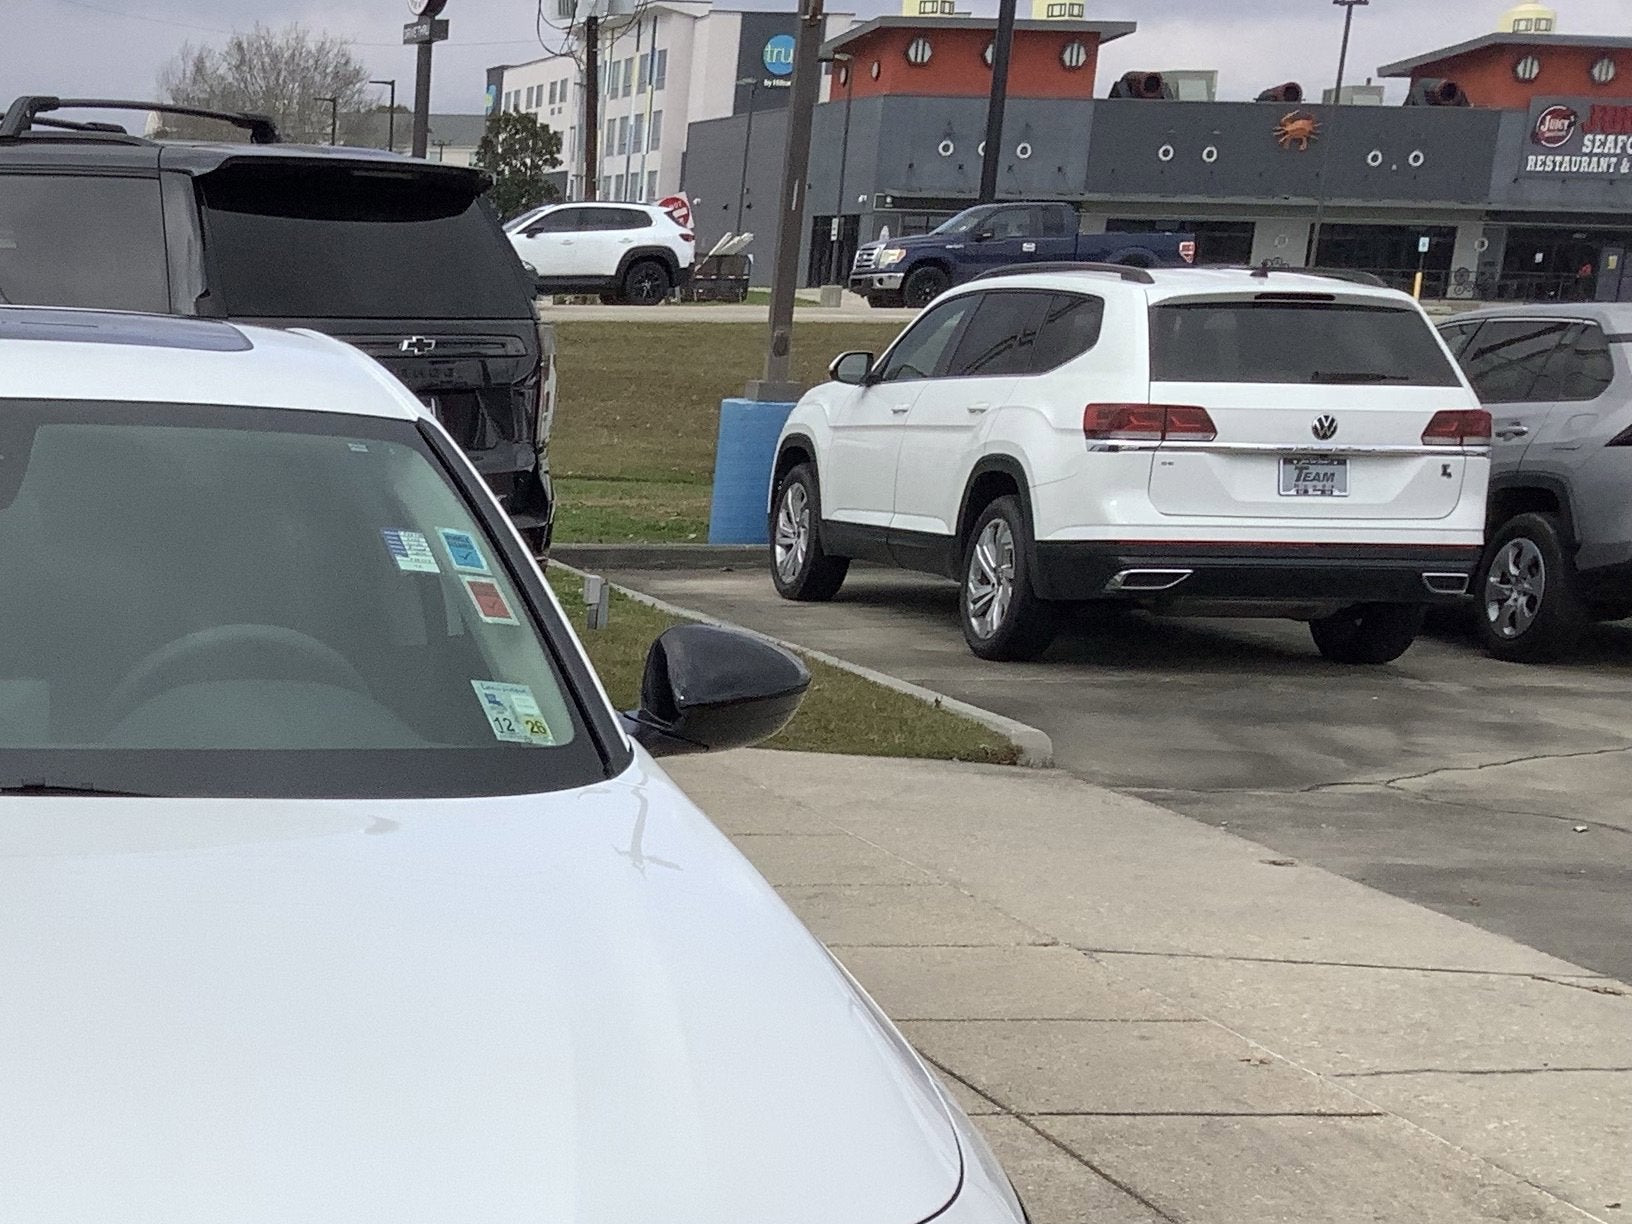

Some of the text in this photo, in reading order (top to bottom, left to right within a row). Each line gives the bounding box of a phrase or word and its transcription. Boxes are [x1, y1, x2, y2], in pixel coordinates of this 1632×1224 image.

[1526, 155, 1617, 173] RESTAURANT
[1294, 464, 1336, 482] TEAM
[494, 717, 515, 734] 12
